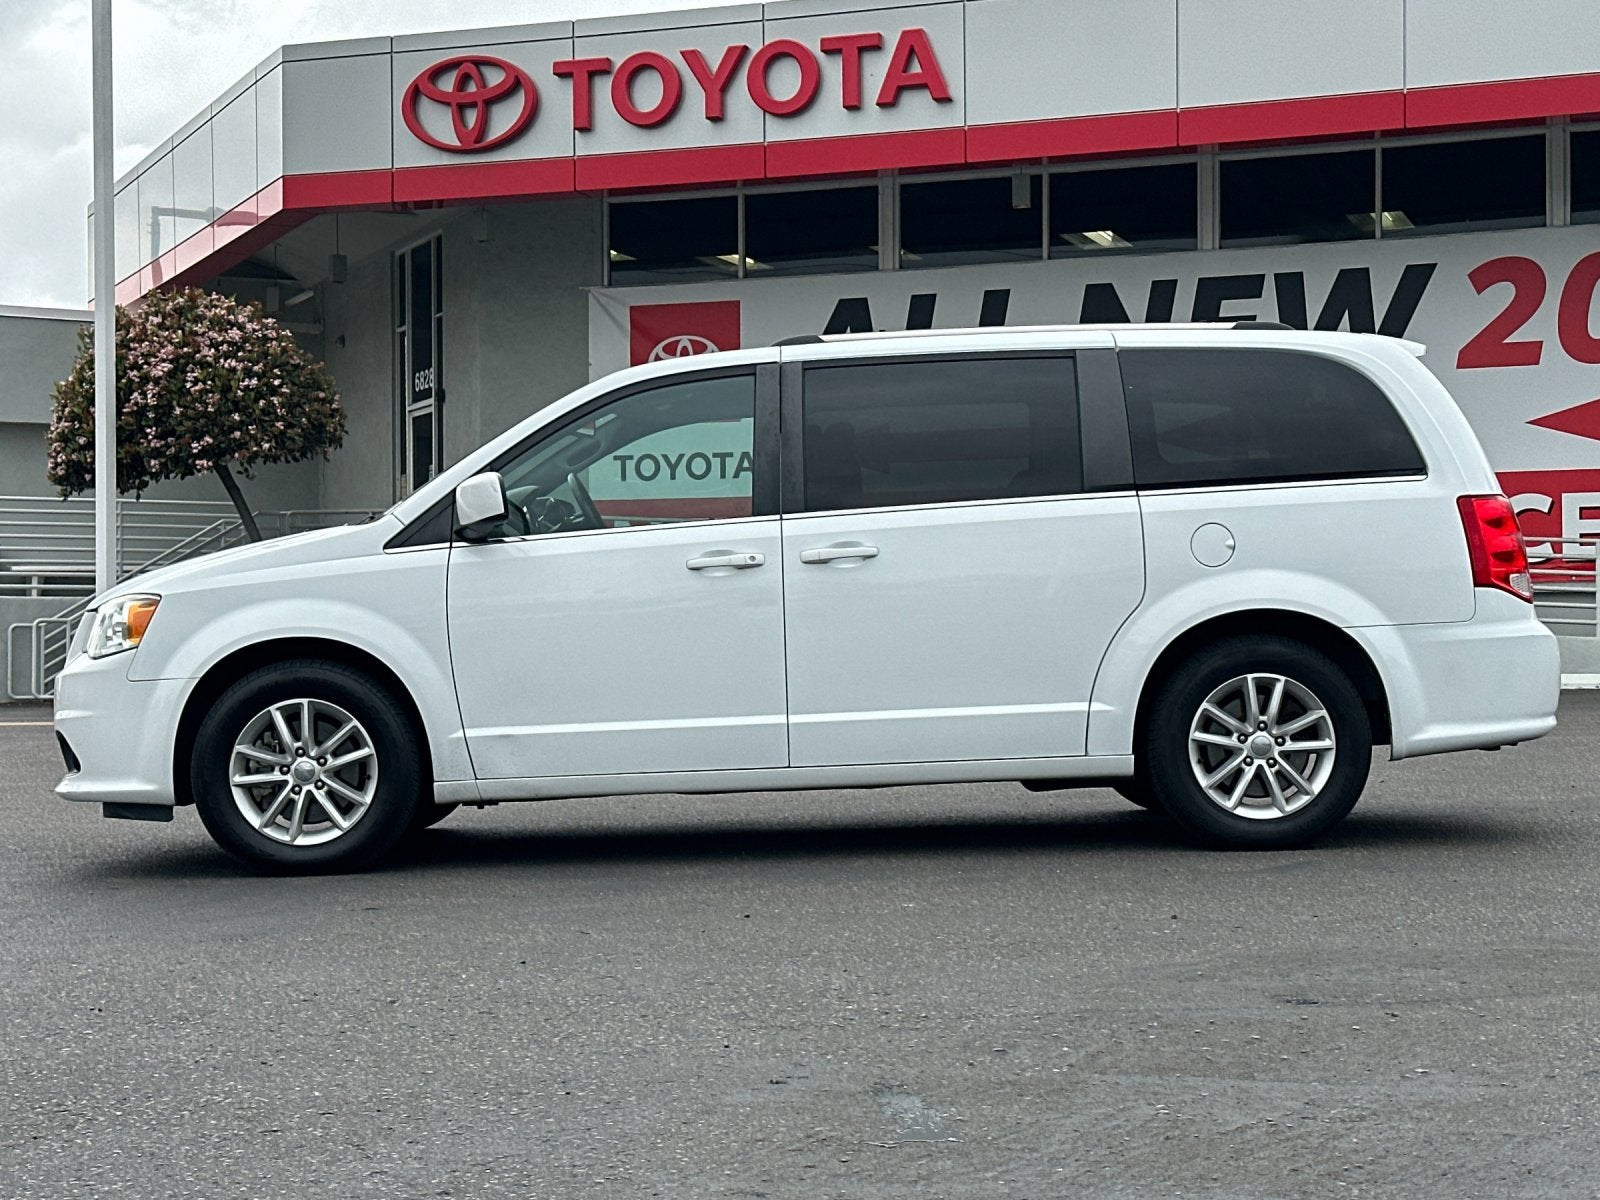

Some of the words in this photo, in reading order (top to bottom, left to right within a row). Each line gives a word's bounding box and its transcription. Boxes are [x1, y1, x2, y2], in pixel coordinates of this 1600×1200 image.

[553, 28, 953, 132] TOYOTA
[414, 367, 434, 392] 6828
[613, 451, 753, 482] TOYOTA
